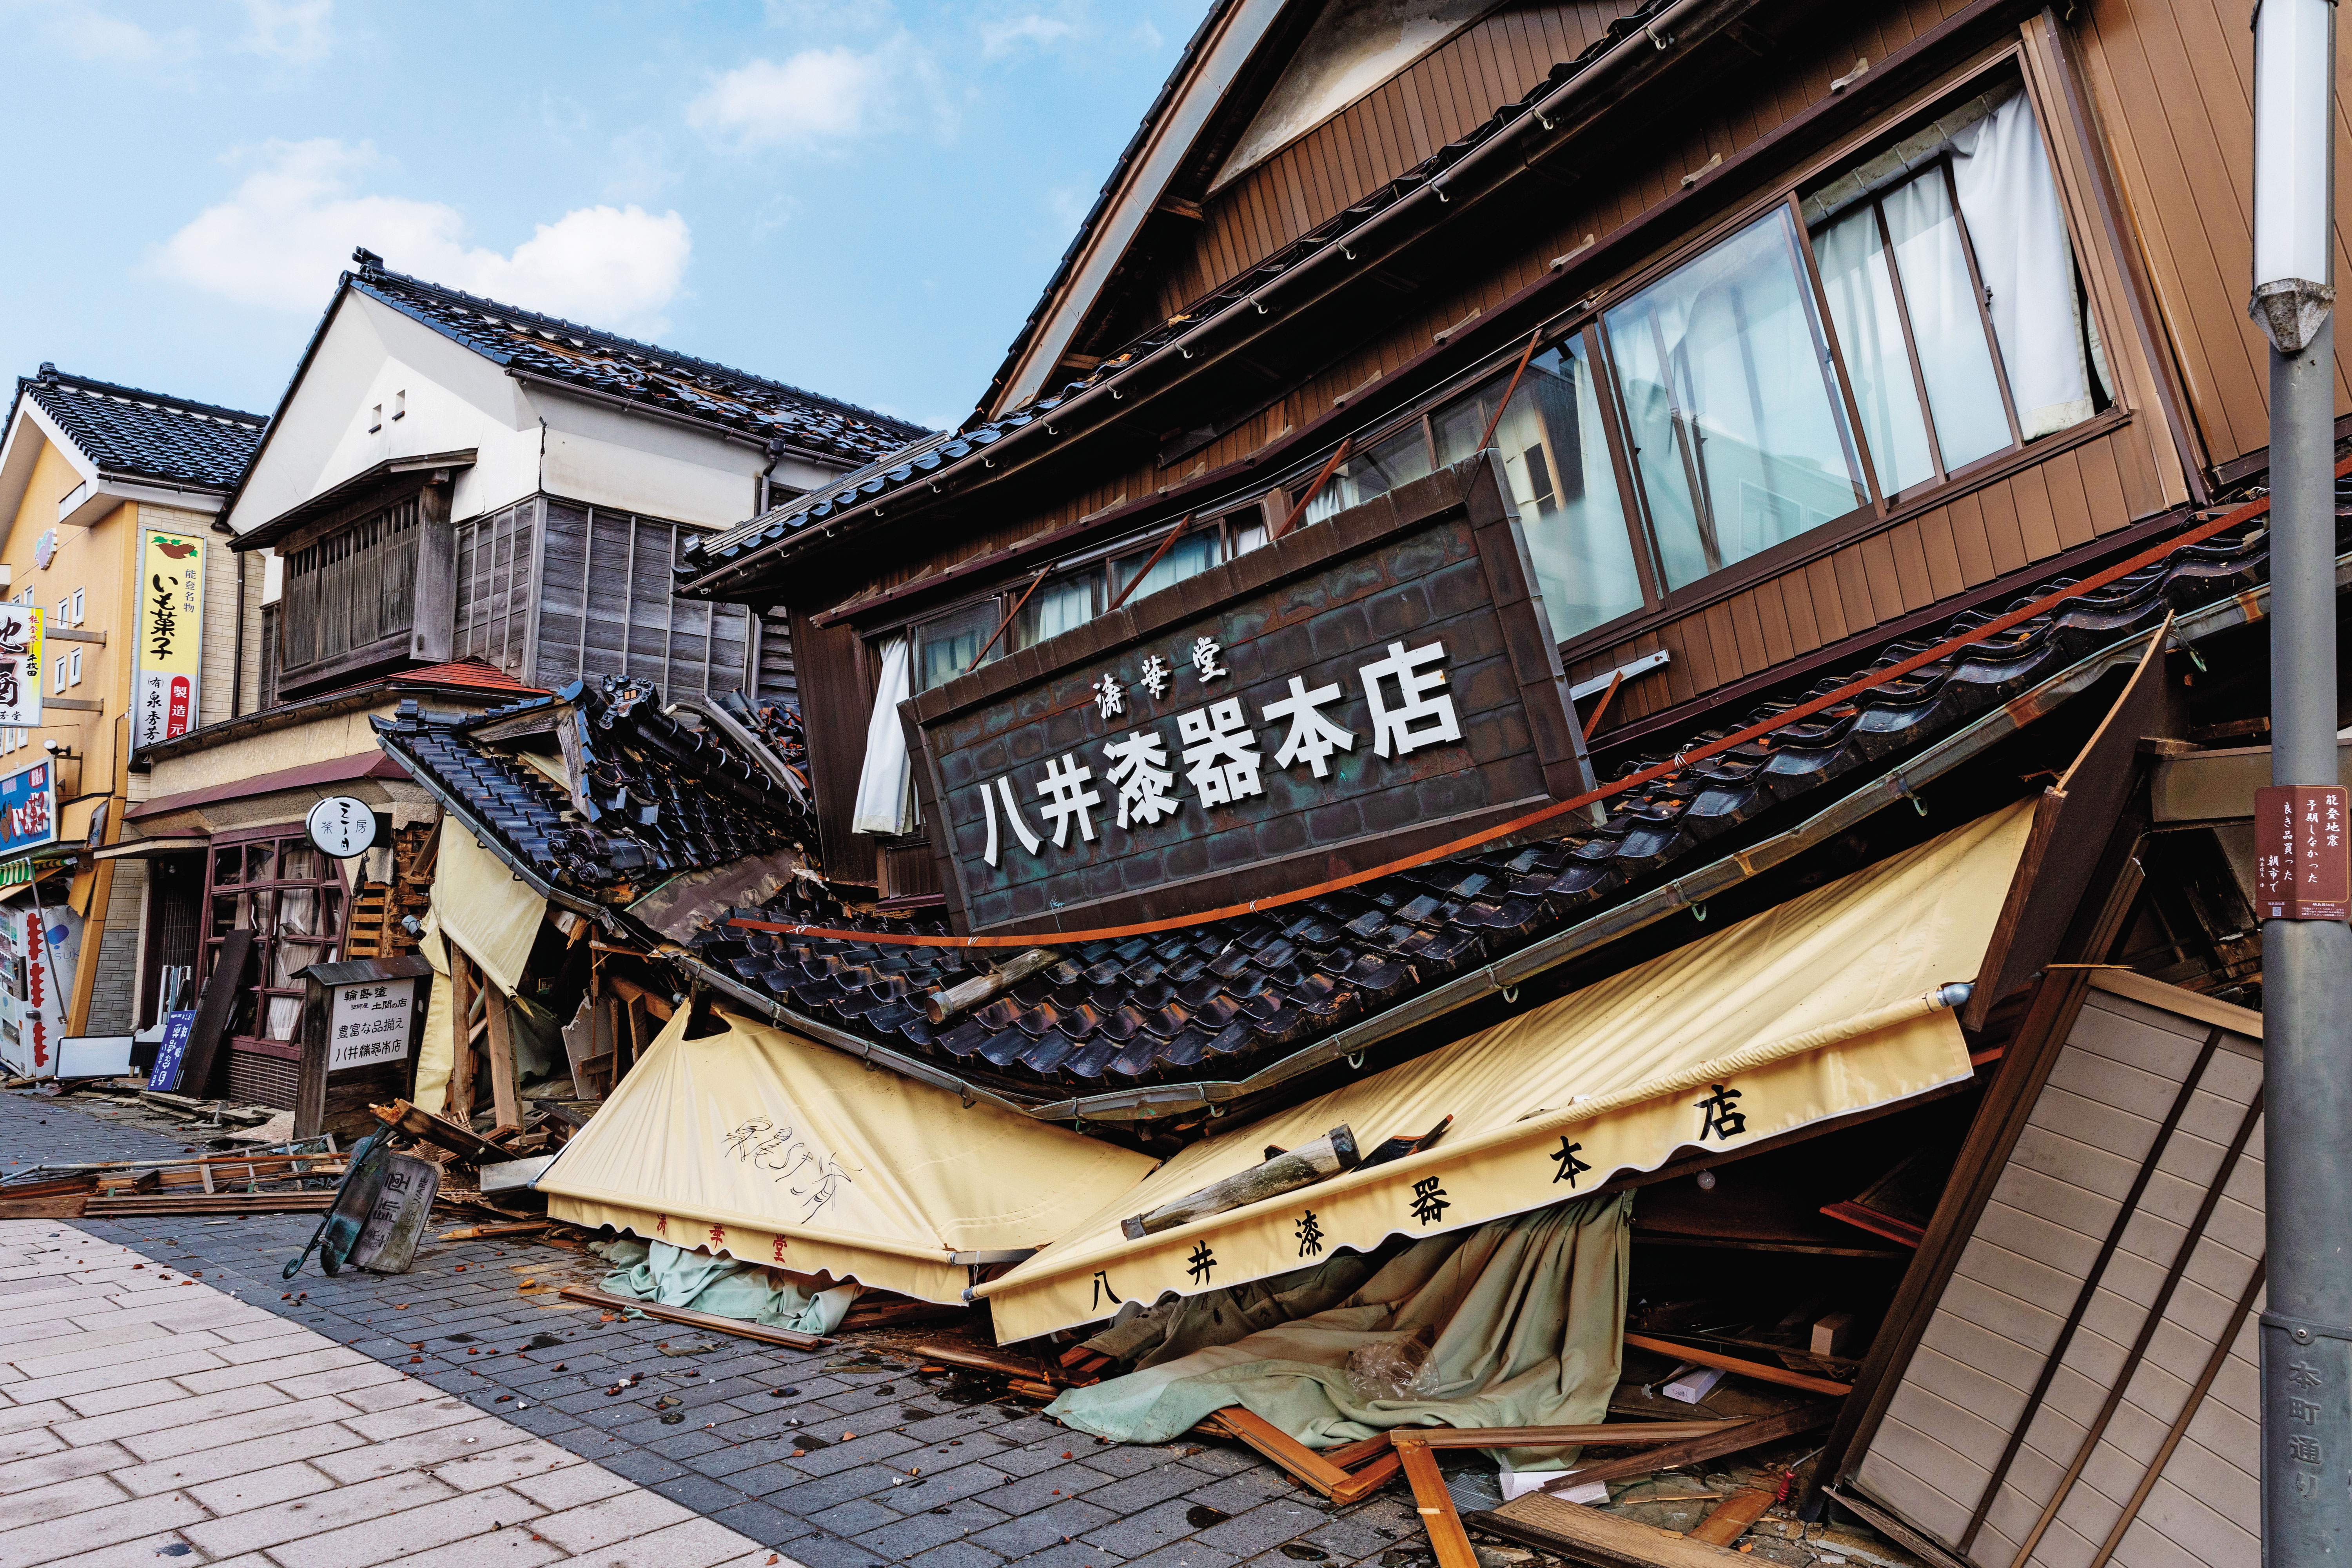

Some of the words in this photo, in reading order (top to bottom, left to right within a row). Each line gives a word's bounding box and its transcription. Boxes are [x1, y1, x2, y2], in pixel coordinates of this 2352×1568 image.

[150, 573, 178, 660] いも菓子
[183, 568, 196, 613] 能登名物
[26, 653, 39, 677] 千枚田
[169, 685, 187, 736] 製造元
[979, 639, 1465, 867] 八井漆器本店
[2283, 802, 2293, 880] 良き品買った
[2305, 799, 2319, 883] 予期しなかった
[2325, 794, 2340, 847] 能登地震
[2267, 855, 2279, 892] 朝市で
[343, 986, 388, 1002] 輪島塗
[371, 998, 408, 1011] 土間の店
[337, 1018, 404, 1039] 豊富な品揃え
[394, 1210, 417, 1256] LACQUER
[412, 1177, 429, 1205] WARE
[1091, 1083, 1747, 1312] 八井漆器本店
[2288, 1361, 2322, 1501] 本町通り
